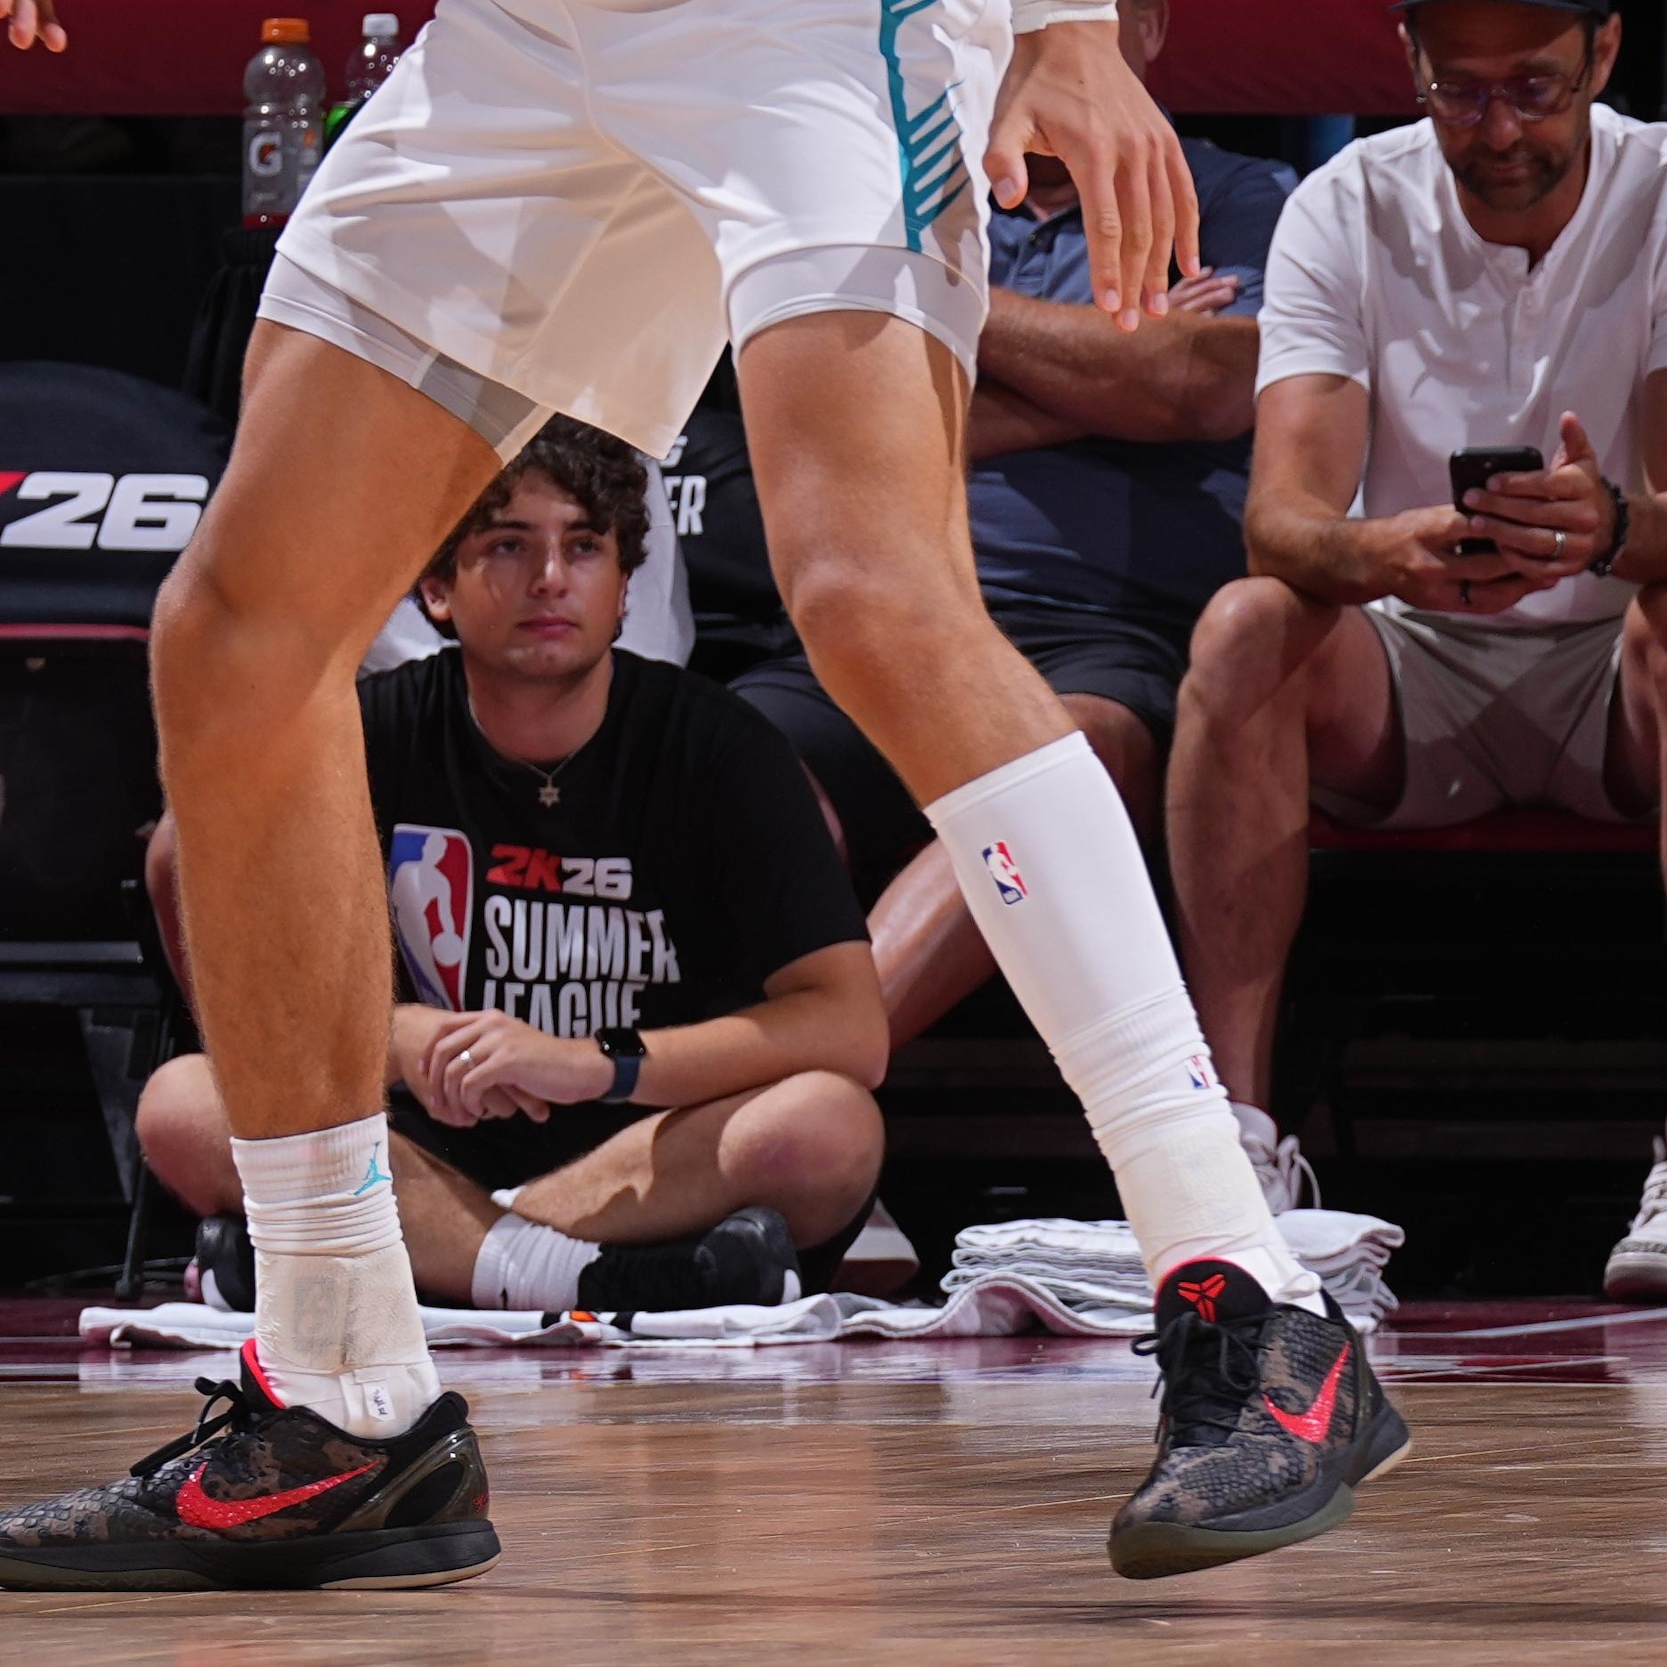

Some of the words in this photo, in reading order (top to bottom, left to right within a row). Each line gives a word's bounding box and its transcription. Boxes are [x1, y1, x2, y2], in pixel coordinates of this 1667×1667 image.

[249, 132, 284, 177] G
[487, 843, 632, 900] 2K26
[484, 895, 681, 984] SUMMER
